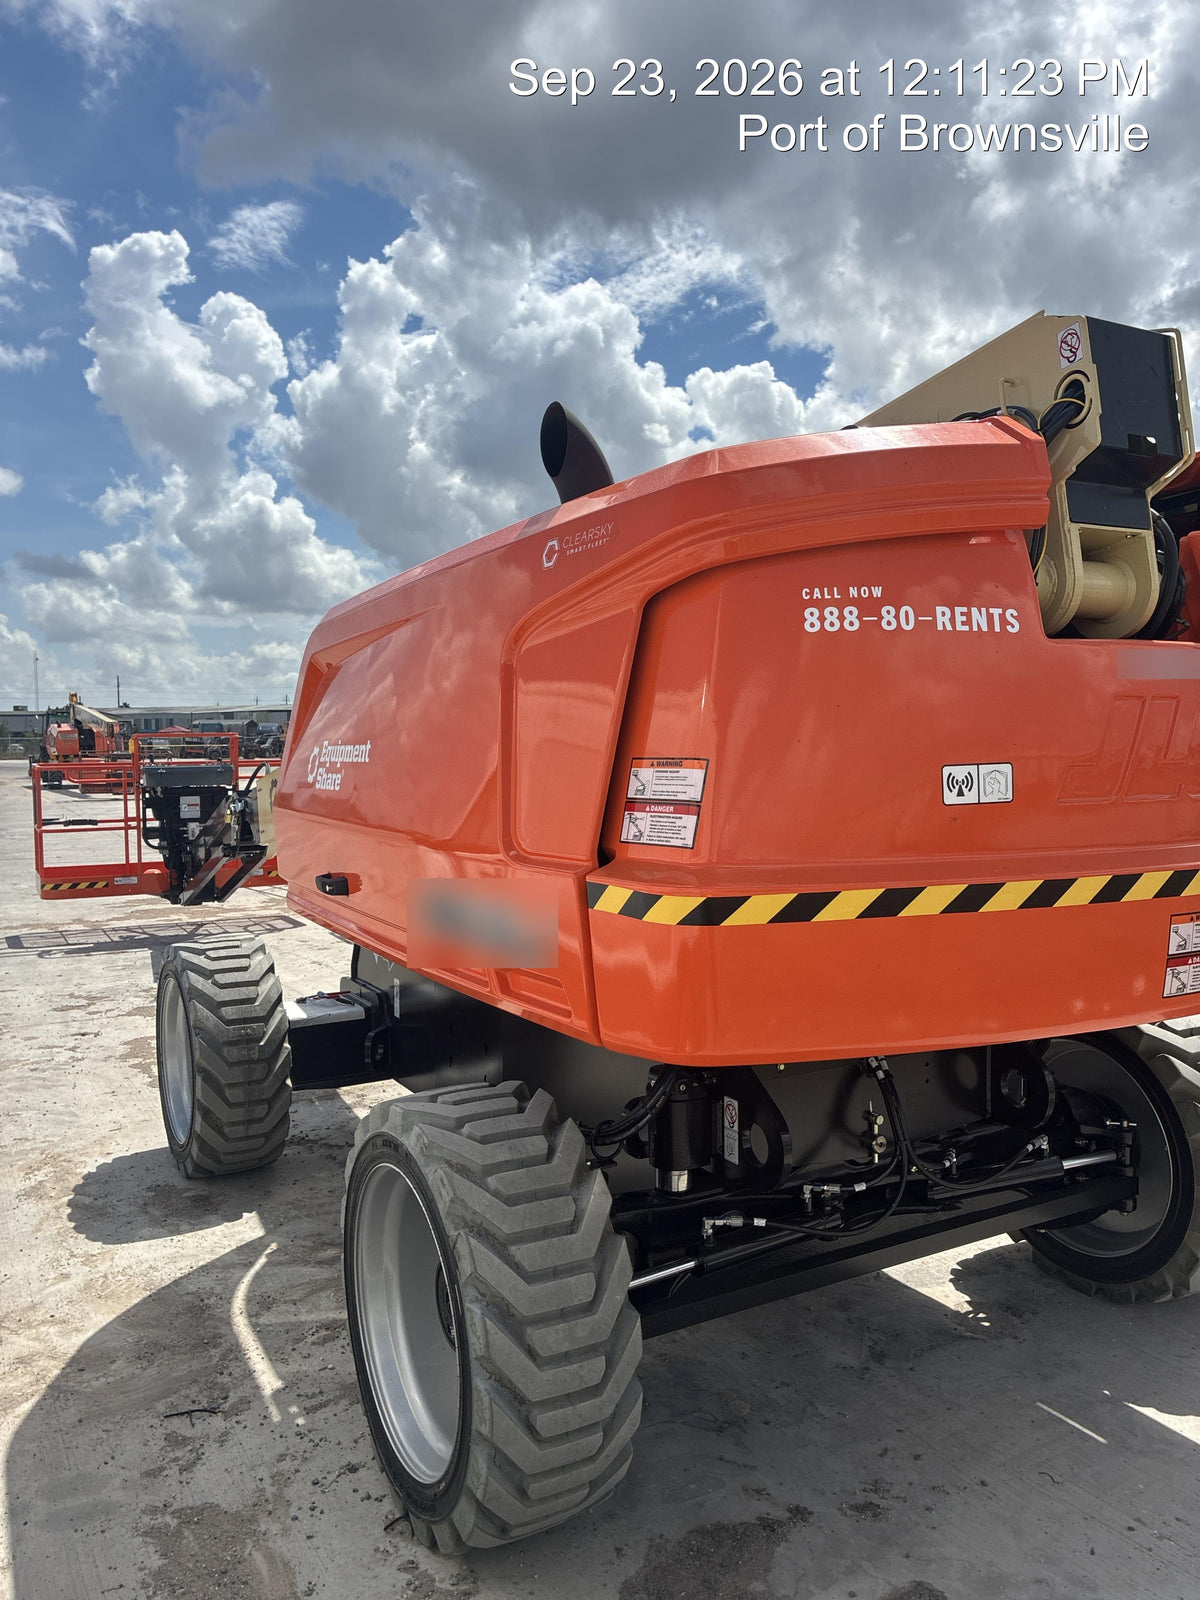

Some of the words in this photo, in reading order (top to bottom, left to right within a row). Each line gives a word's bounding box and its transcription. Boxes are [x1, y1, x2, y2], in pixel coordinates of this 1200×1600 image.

[562, 521, 614, 549] CLEARSKY
[801, 587, 841, 600] CALL
[849, 586, 883, 598] NOW
[803, 605, 1020, 633] 888-80-RENTS
[320, 740, 371, 767] Equipment
[656, 760, 683, 768] WARNING
[315, 767, 342, 790] Share
[650, 805, 674, 813] DANGER
